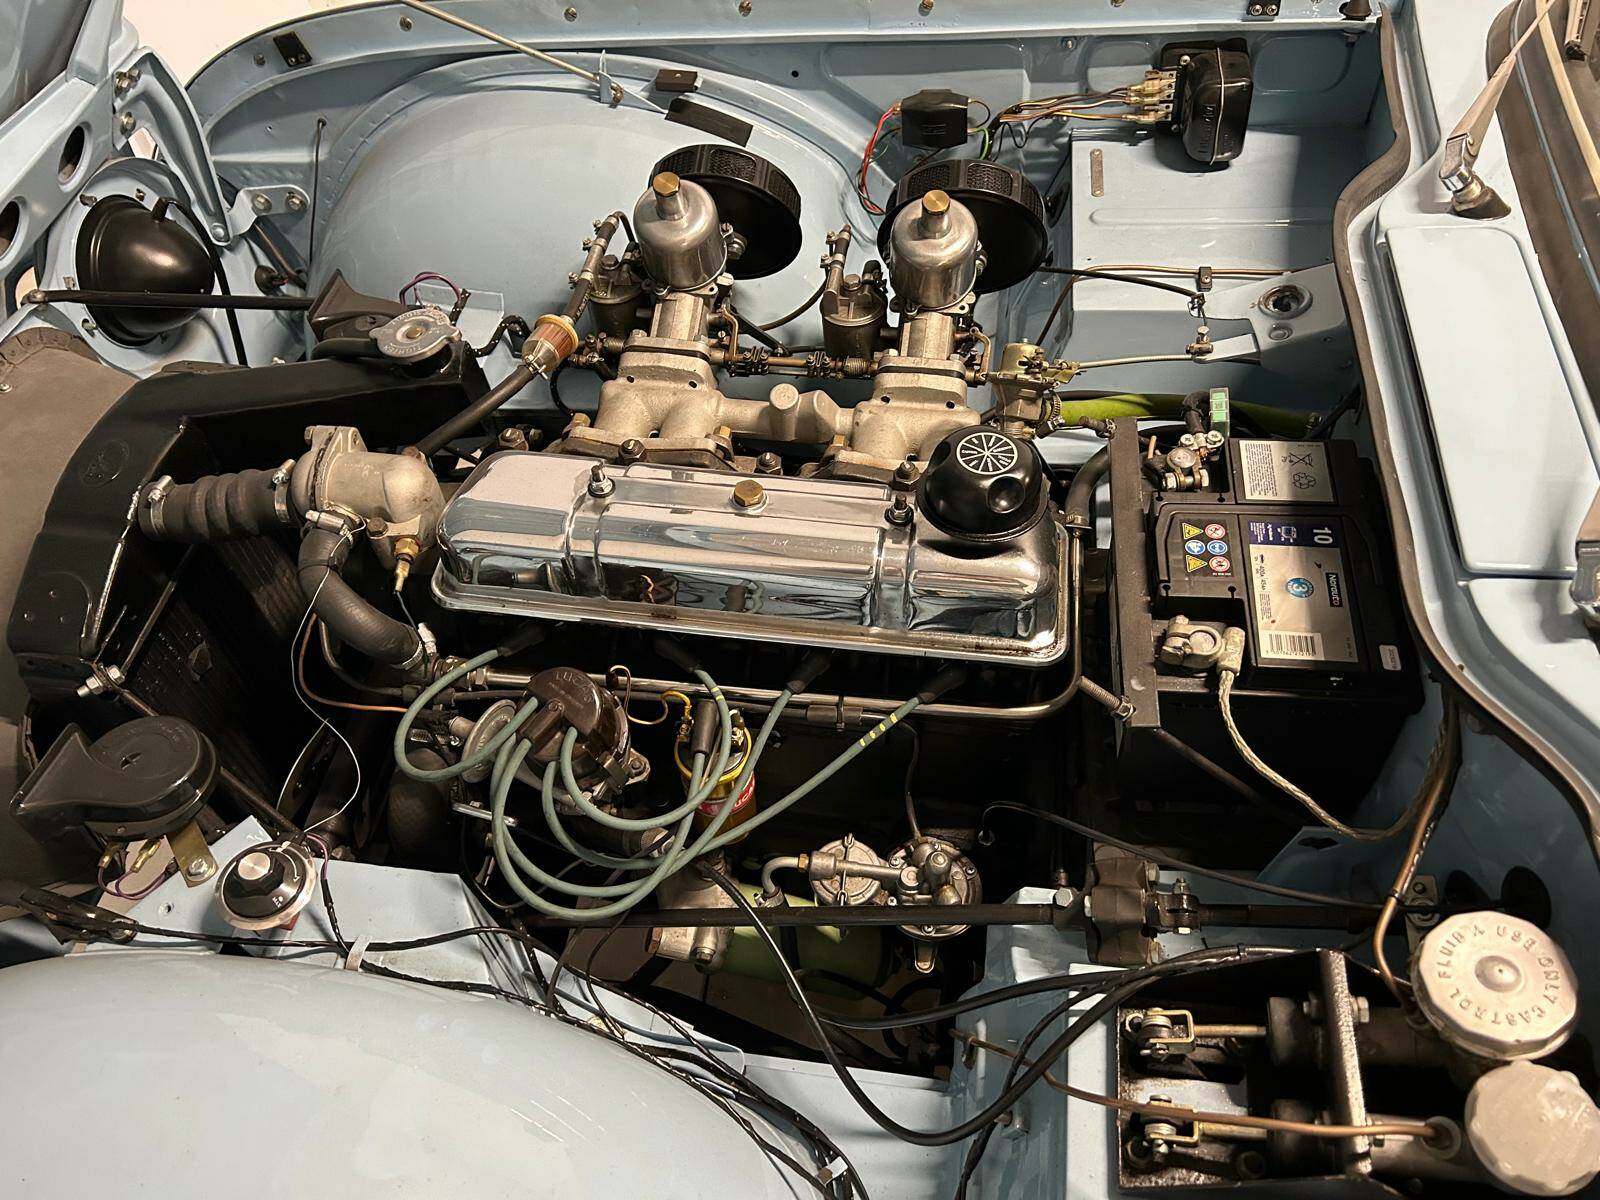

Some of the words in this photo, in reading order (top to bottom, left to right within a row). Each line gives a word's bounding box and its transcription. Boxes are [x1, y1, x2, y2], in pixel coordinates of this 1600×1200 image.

[1313, 527, 1333, 544] 10
[1328, 574, 1340, 606] Norauto
[1436, 931, 1465, 979] FLUID
[1496, 925, 1536, 951] USE
[1538, 956, 1560, 1004] ONLY
[1450, 988, 1546, 1026] CASTROL
